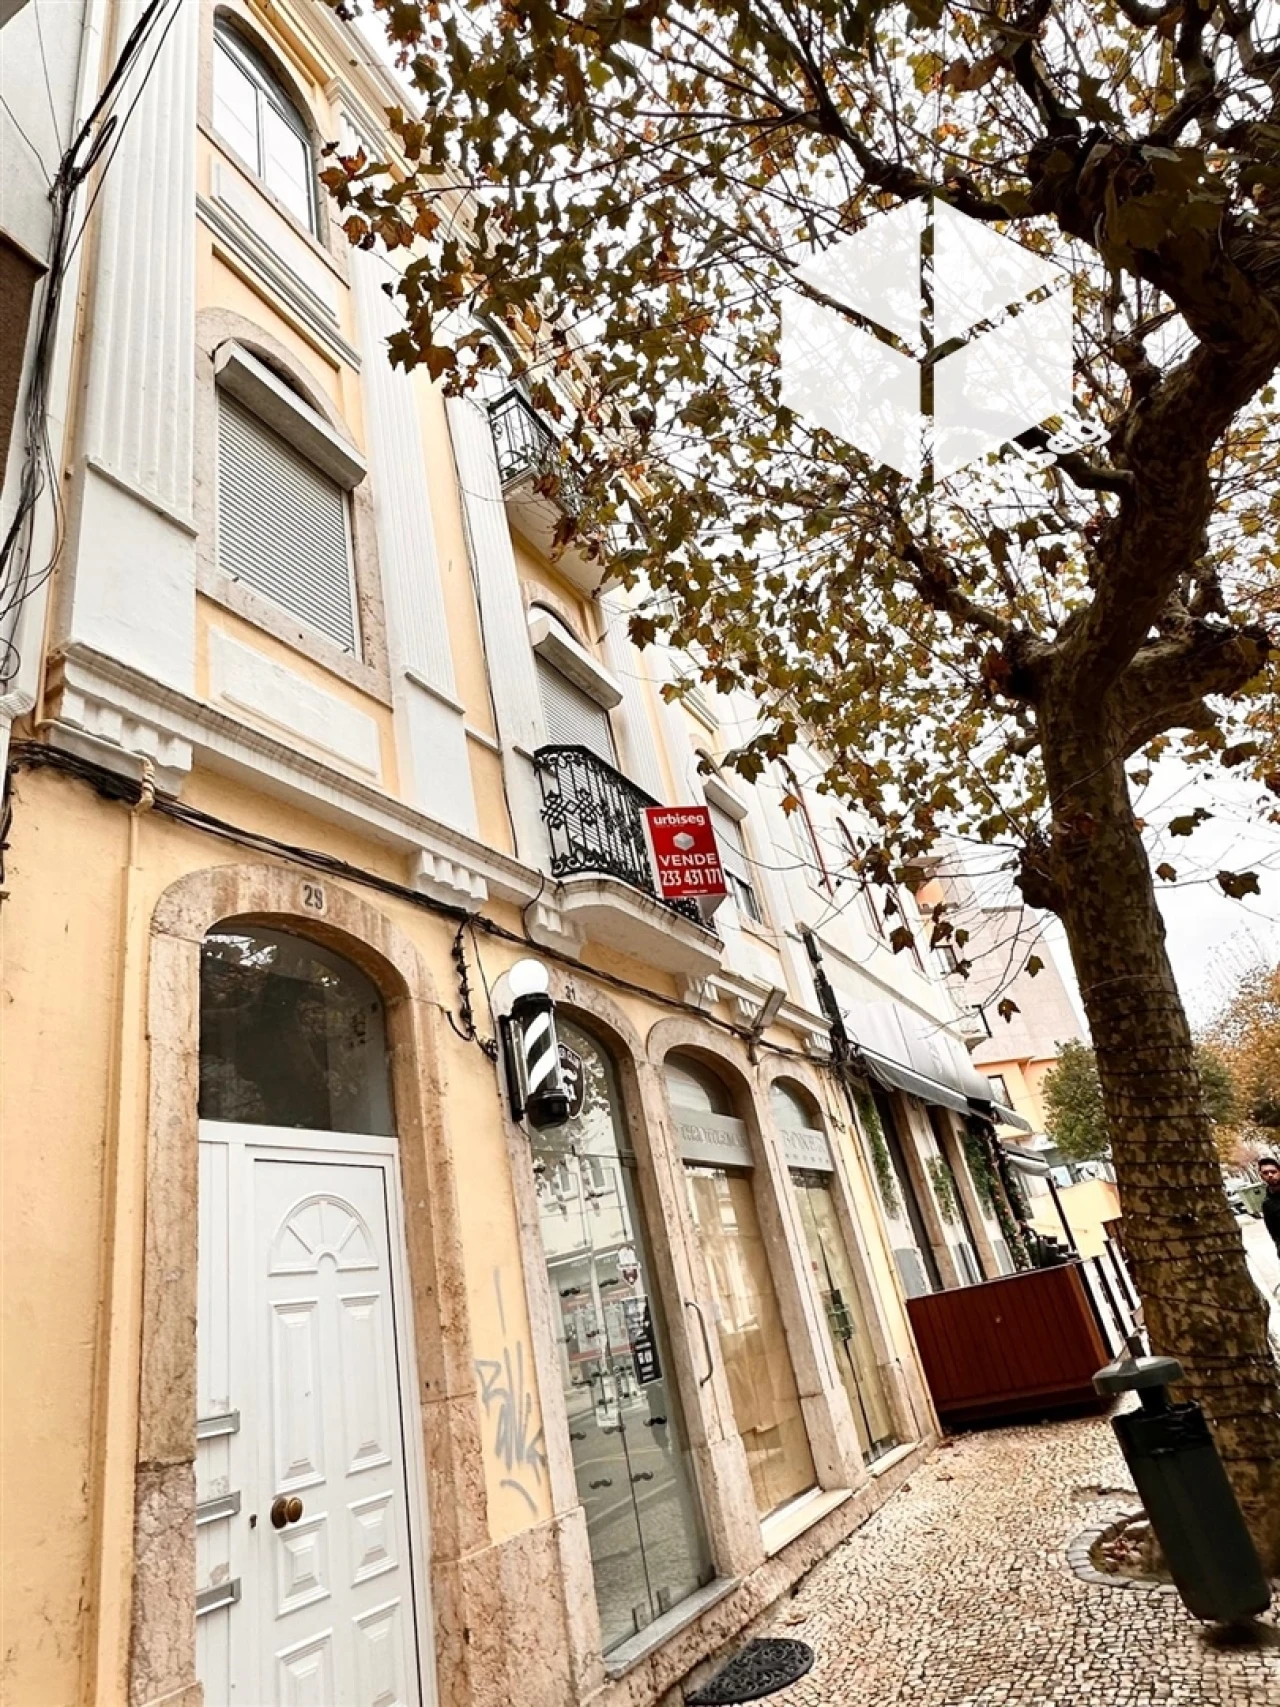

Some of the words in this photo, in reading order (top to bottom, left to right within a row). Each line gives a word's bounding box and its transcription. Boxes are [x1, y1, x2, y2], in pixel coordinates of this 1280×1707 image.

[653, 813, 705, 826] urbiseg
[659, 853, 717, 867] VENDE
[661, 870, 682, 886] 233
[684, 869, 704, 885] 431
[705, 868, 723, 884] 171
[304, 884, 323, 909] 29
